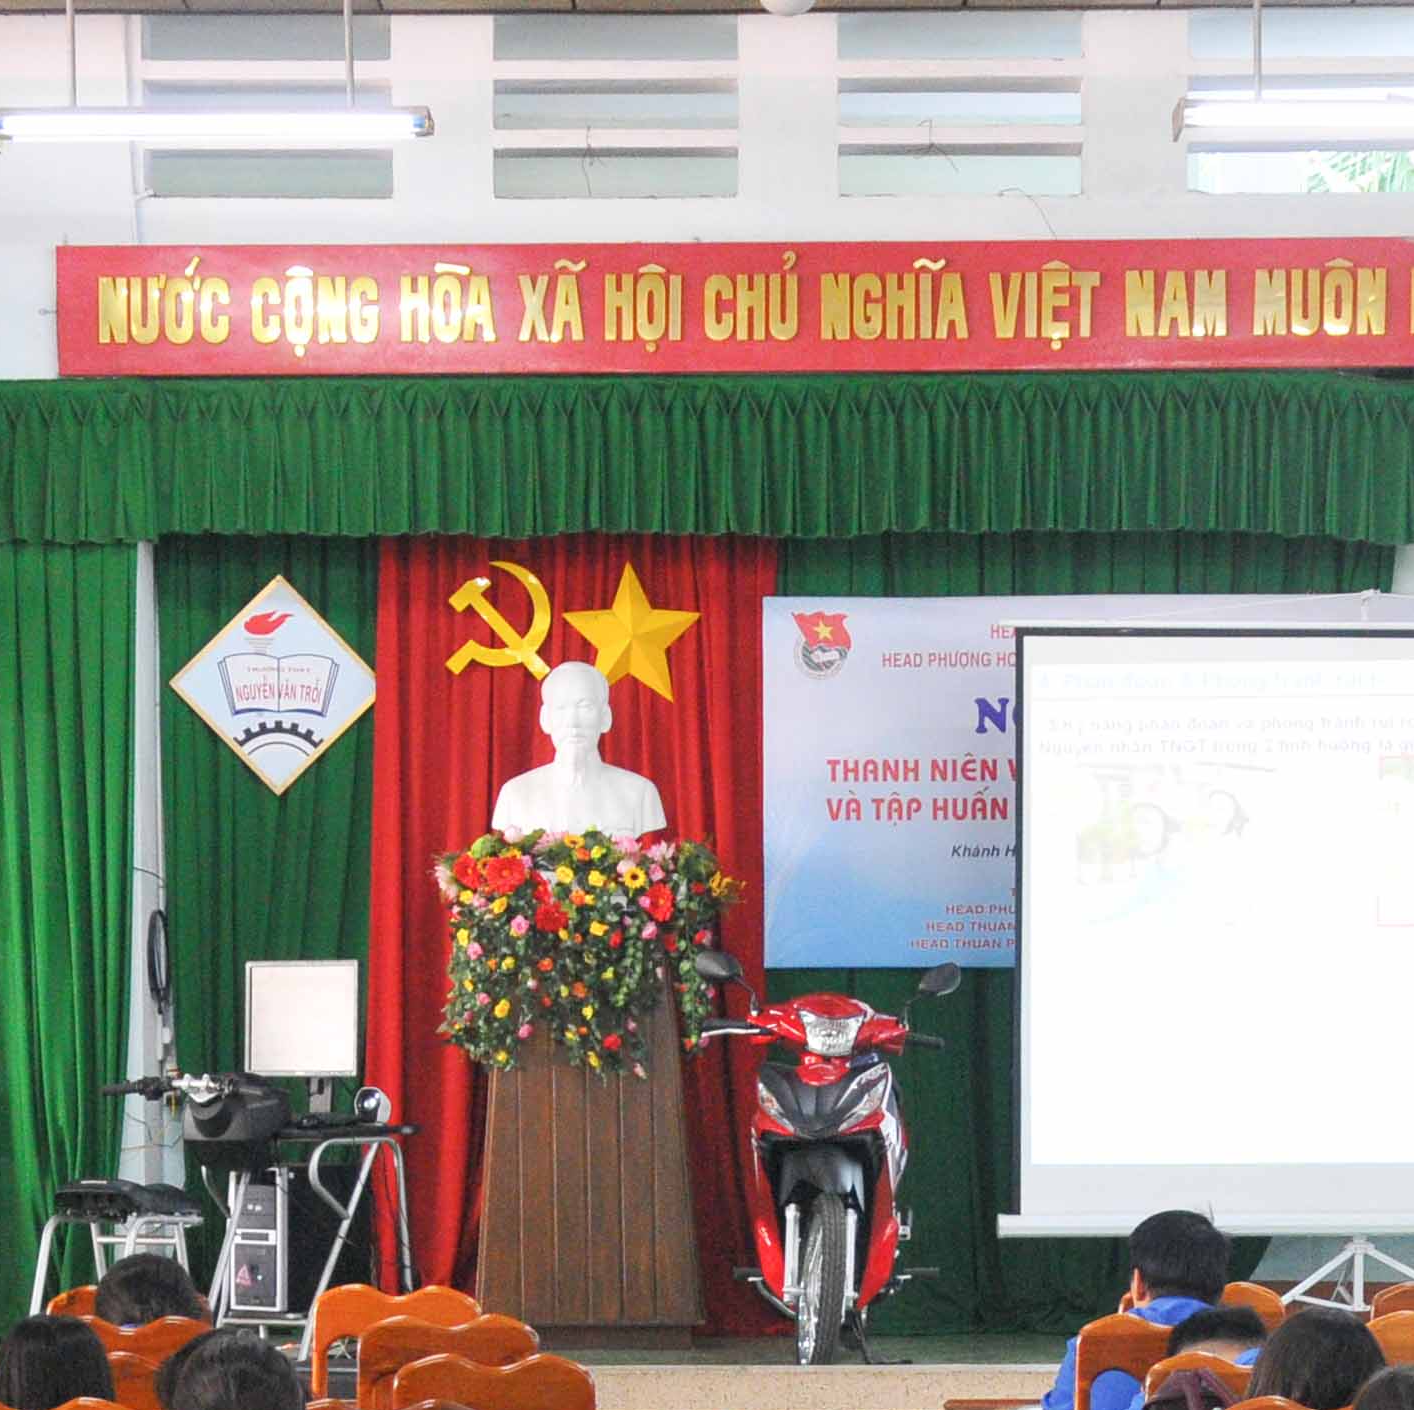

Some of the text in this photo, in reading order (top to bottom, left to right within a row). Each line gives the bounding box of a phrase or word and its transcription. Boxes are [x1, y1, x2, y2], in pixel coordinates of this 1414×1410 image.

[98, 256, 230, 344] NƯỚC
[251, 265, 379, 357] CỘNG
[400, 262, 496, 344] HÒA
[518, 258, 587, 342] XÃ
[604, 264, 682, 353] HỘI
[703, 250, 798, 341] CHỦ
[819, 257, 969, 341] NGHĨA
[989, 260, 1101, 351] VIỆT
[1125, 269, 1227, 338] NAM
[1253, 258, 1387, 336] MUÔN
[882, 651, 923, 668] HEAD
[996, 651, 1017, 668] HO
[826, 759, 920, 782] THANH
[930, 752, 998, 782] NIÊN
[826, 786, 1008, 827] VÀ TẬP HUẤN
[945, 903, 985, 915] HEAD
[926, 920, 964, 932] HEAD
